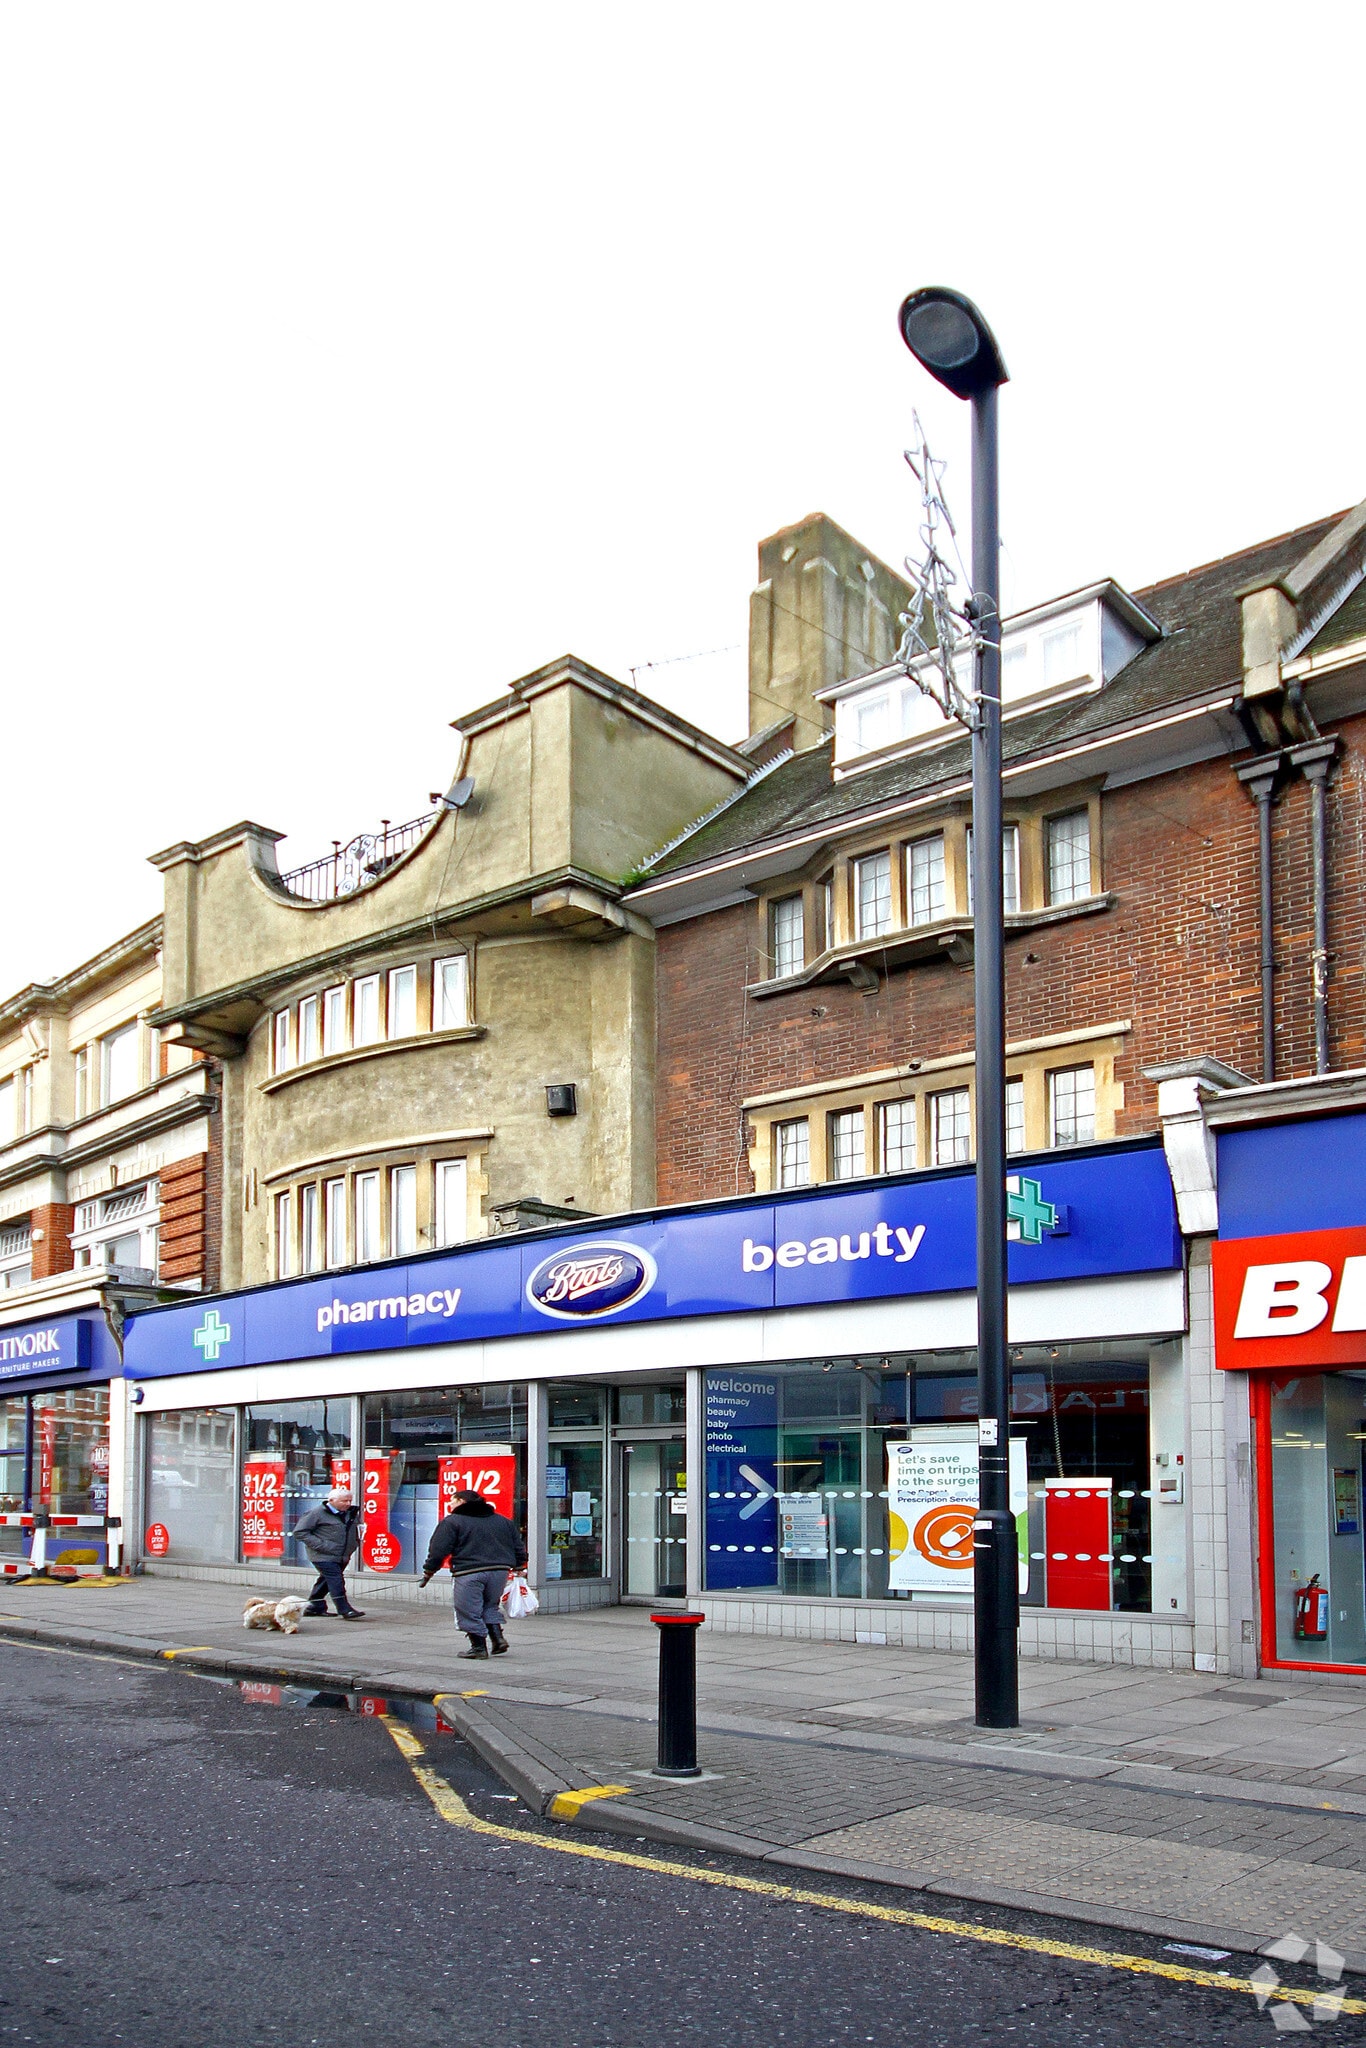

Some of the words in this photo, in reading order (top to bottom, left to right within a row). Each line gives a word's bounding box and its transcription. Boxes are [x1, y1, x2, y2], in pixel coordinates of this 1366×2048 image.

[742, 1221, 926, 1273] beauty
[540, 1254, 623, 1302] Boots
[317, 1287, 461, 1332] pharmacy
[0, 1328, 60, 1360] TIYORK
[0, 1362, 31, 1374] RNITURE
[32, 1357, 60, 1369] MAKERS
[707, 1378, 776, 1395] welcome
[664, 1397, 687, 1409] 315
[707, 1395, 750, 1406] pharmacy
[707, 1407, 737, 1418] beauty
[707, 1419, 729, 1430] baby
[707, 1431, 733, 1441] photo
[707, 1443, 747, 1453] electrical
[898, 1456, 926, 1464] Let's
[929, 1456, 960, 1464] save
[898, 1466, 925, 1475] time
[928, 1467, 945, 1475] on
[948, 1465, 979, 1475] trips
[336, 1472, 350, 1484] up
[443, 1471, 460, 1483] up
[461, 1470, 501, 1495] 1/2
[913, 1477, 934, 1486] the
[937, 1478, 980, 1487] surger
[252, 1473, 277, 1495] 1/2
[443, 1483, 457, 1495] to
[897, 1496, 950, 1504] Prescription
[151, 1536, 165, 1544] price
[376, 1537, 388, 1547] 1/2
[555, 1533, 566, 1541] 25
[371, 1546, 392, 1557] price
[373, 1555, 390, 1564] sale
